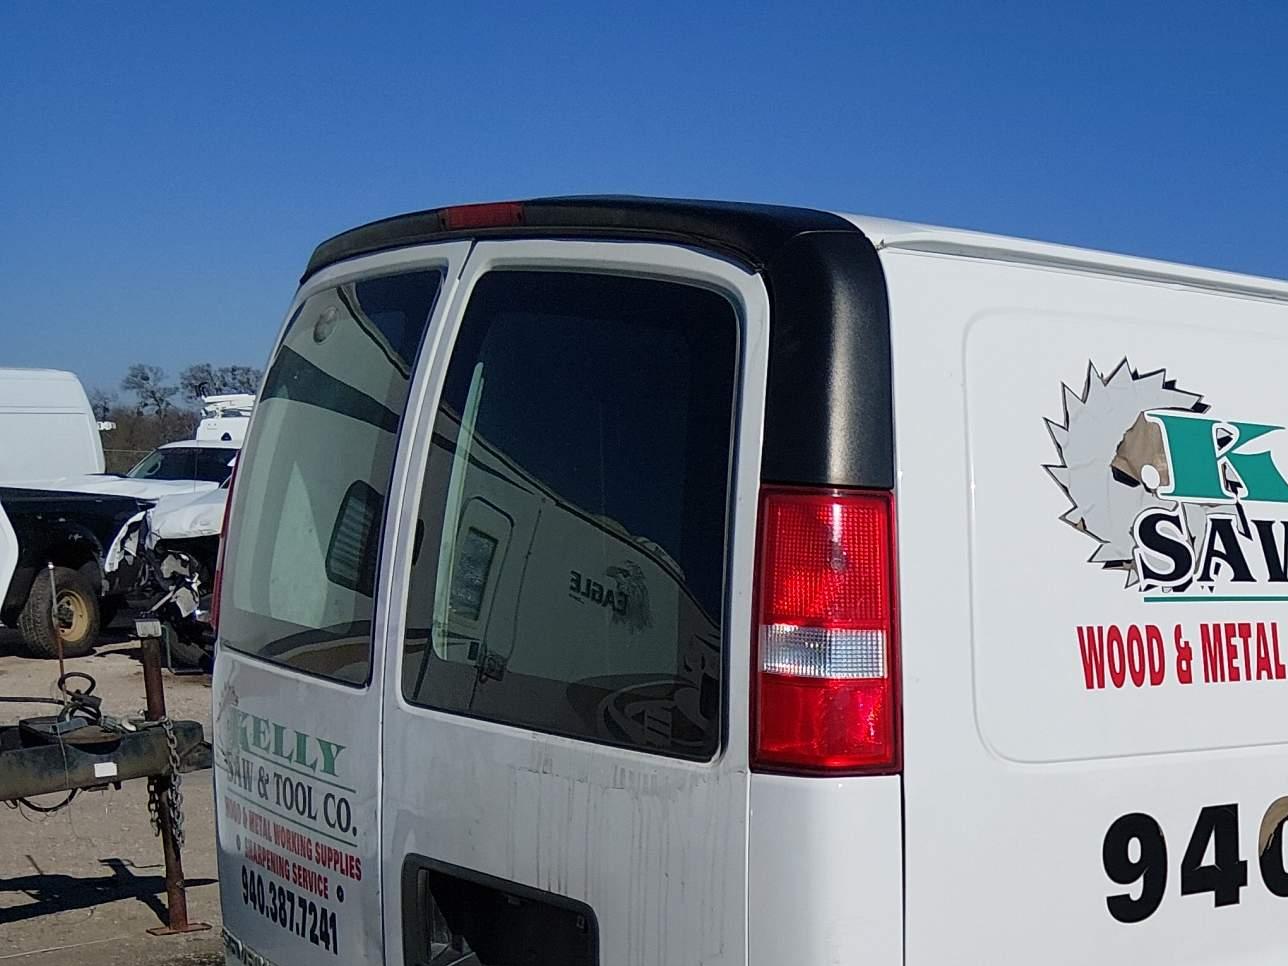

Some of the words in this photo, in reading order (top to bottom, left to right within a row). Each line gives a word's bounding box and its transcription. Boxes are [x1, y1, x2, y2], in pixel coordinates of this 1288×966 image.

[1076, 623, 1166, 691] WOOD
[1175, 624, 1193, 685] &
[1200, 619, 1287, 684] METAL
[230, 705, 347, 778] KELLY
[227, 754, 254, 793] SAW
[257, 765, 269, 801] &
[273, 771, 318, 821] TOOL
[323, 792, 358, 837] CO.
[244, 837, 290, 882] SHARPENING
[292, 862, 329, 900] SERVICE
[248, 809, 273, 842] METAL
[272, 821, 313, 862] WORKING
[314, 841, 362, 881] SUPPLIES
[241, 864, 338, 956] 940.387.7241
